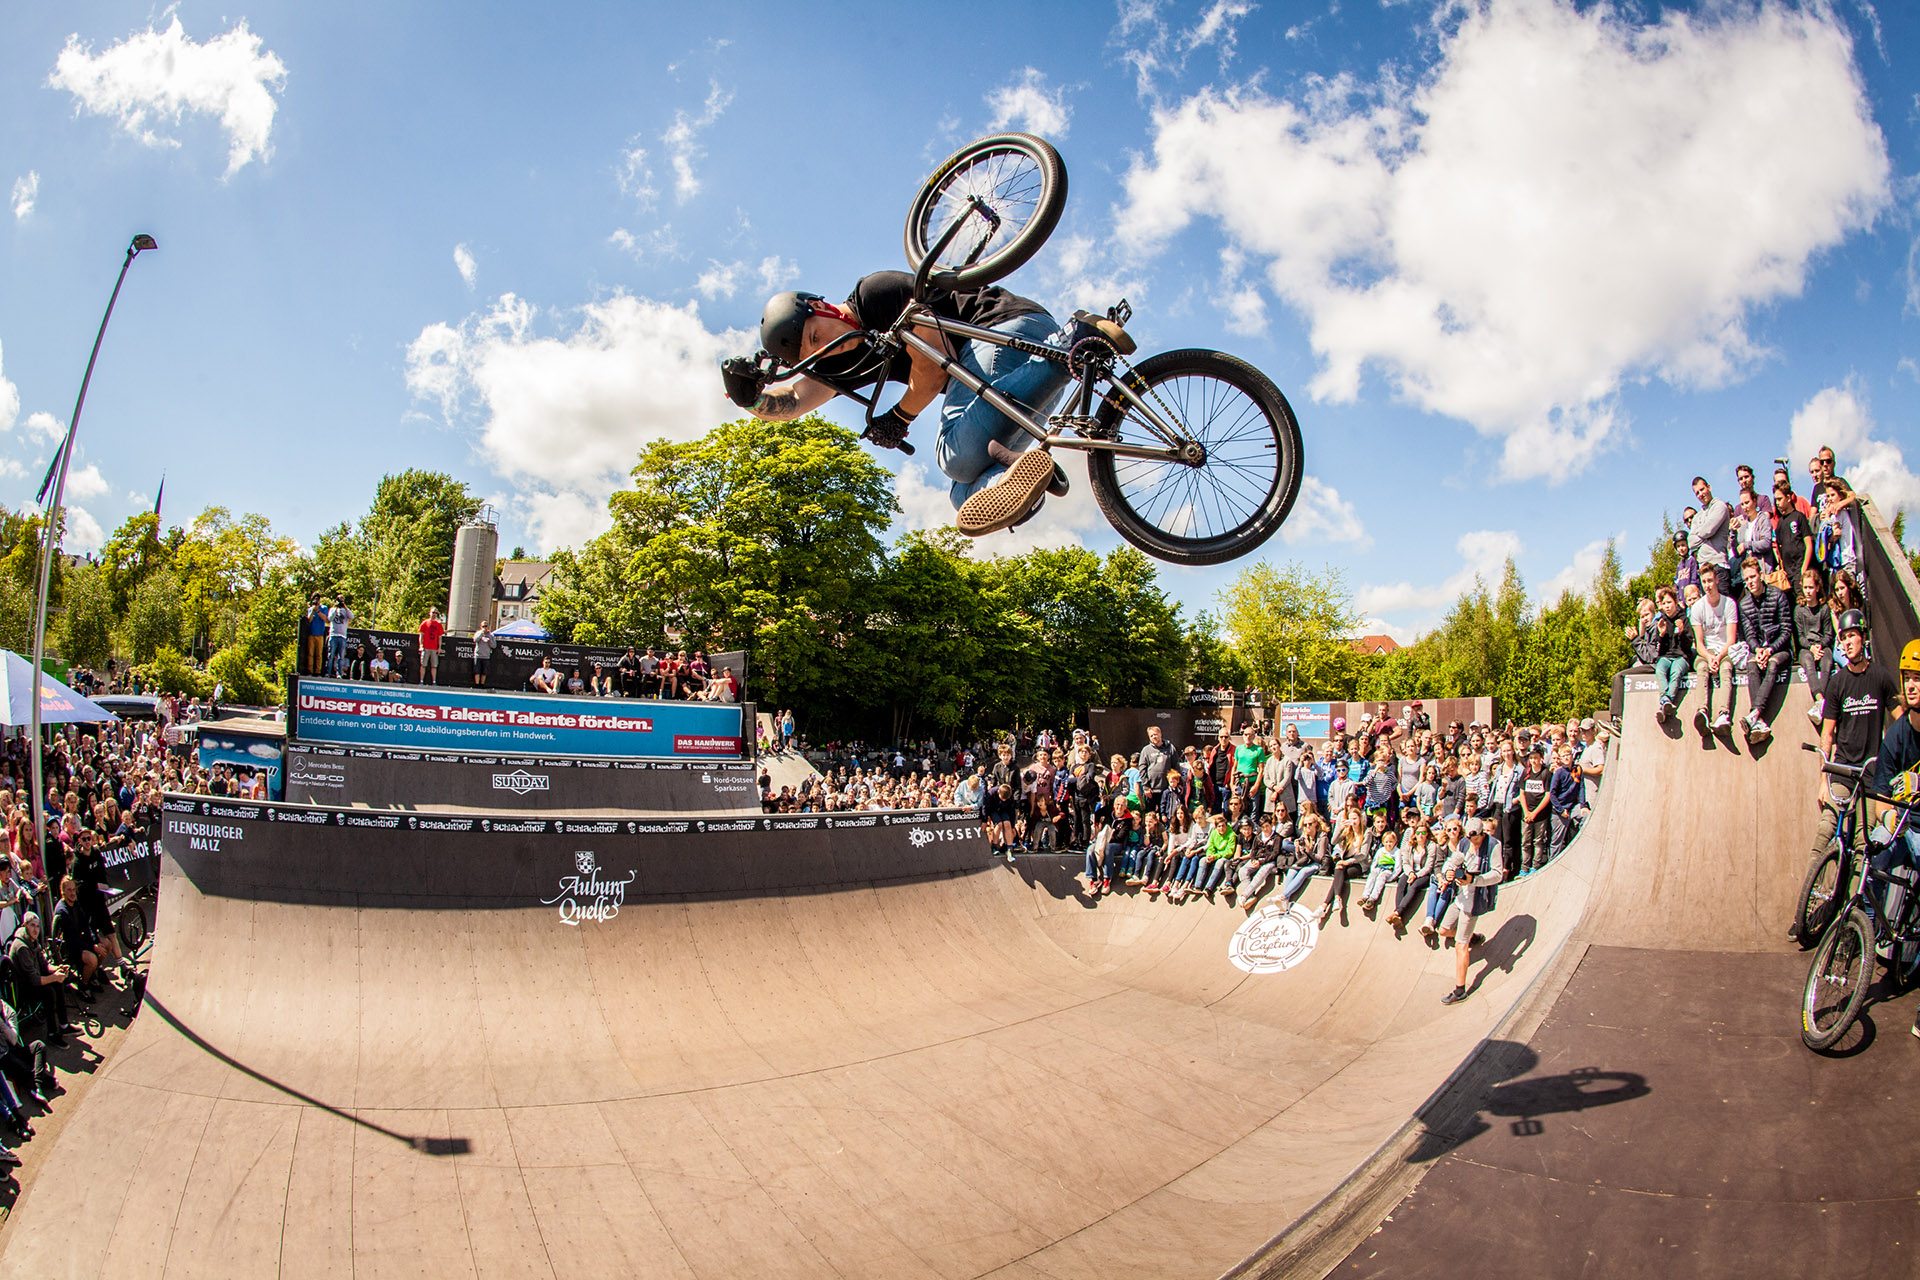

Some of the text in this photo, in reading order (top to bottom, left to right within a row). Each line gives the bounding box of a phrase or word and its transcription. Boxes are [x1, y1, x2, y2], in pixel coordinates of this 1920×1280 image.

[382, 637, 411, 647] NAH.SH
[515, 648, 544, 657] NAH.SH
[301, 695, 653, 730] Unser größtes Talent: Talente fördern.
[300, 715, 557, 741] Entdecke einen von über 130 Ausbildungsberufen im Handwerk.
[694, 738, 736, 747] HANDWERK
[494, 776, 547, 788] SUNDAY
[713, 776, 754, 784] Nord-Ostsee
[714, 784, 748, 793] Sparkasse
[168, 821, 243, 840] FLENSBURGER
[540, 866, 636, 907] Auburg
[559, 895, 619, 927] Quelle
[1249, 937, 1299, 954] Capture
